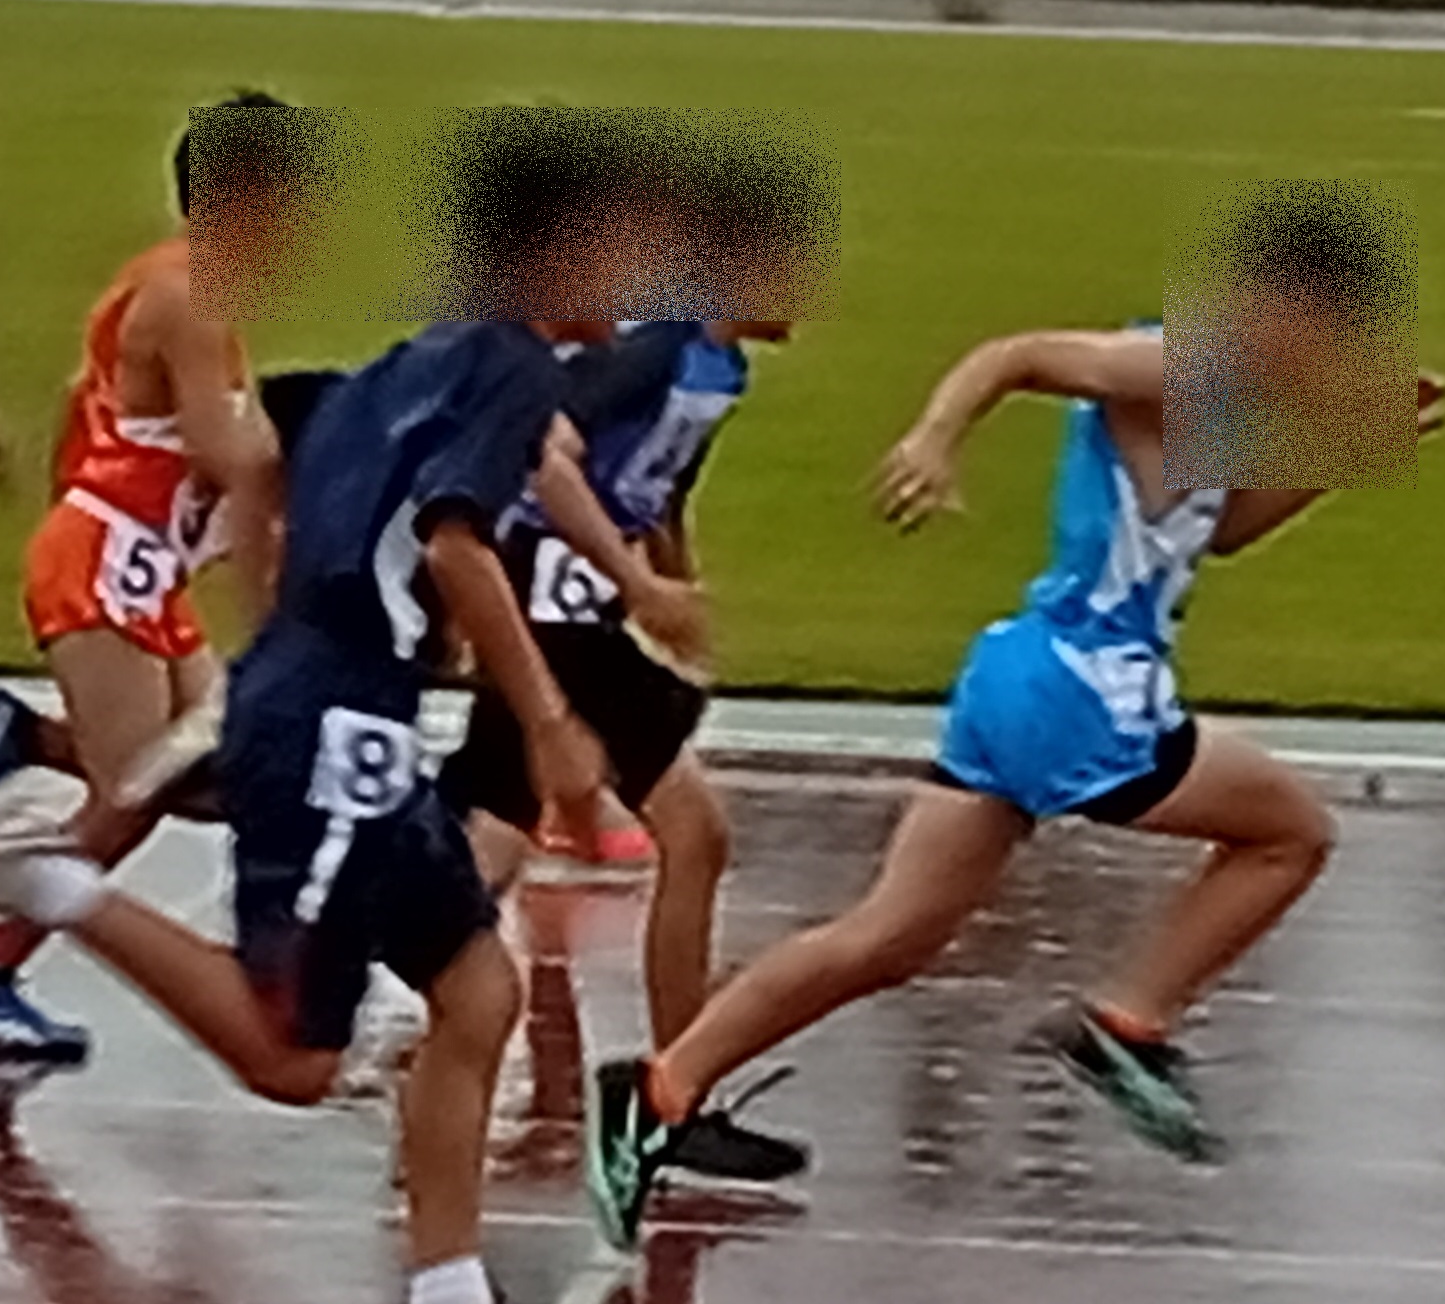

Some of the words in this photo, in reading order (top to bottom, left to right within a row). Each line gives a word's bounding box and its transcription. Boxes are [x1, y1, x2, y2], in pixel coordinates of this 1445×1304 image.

[120, 538, 159, 597] 5
[550, 553, 596, 616] 6
[343, 730, 398, 806] 8
